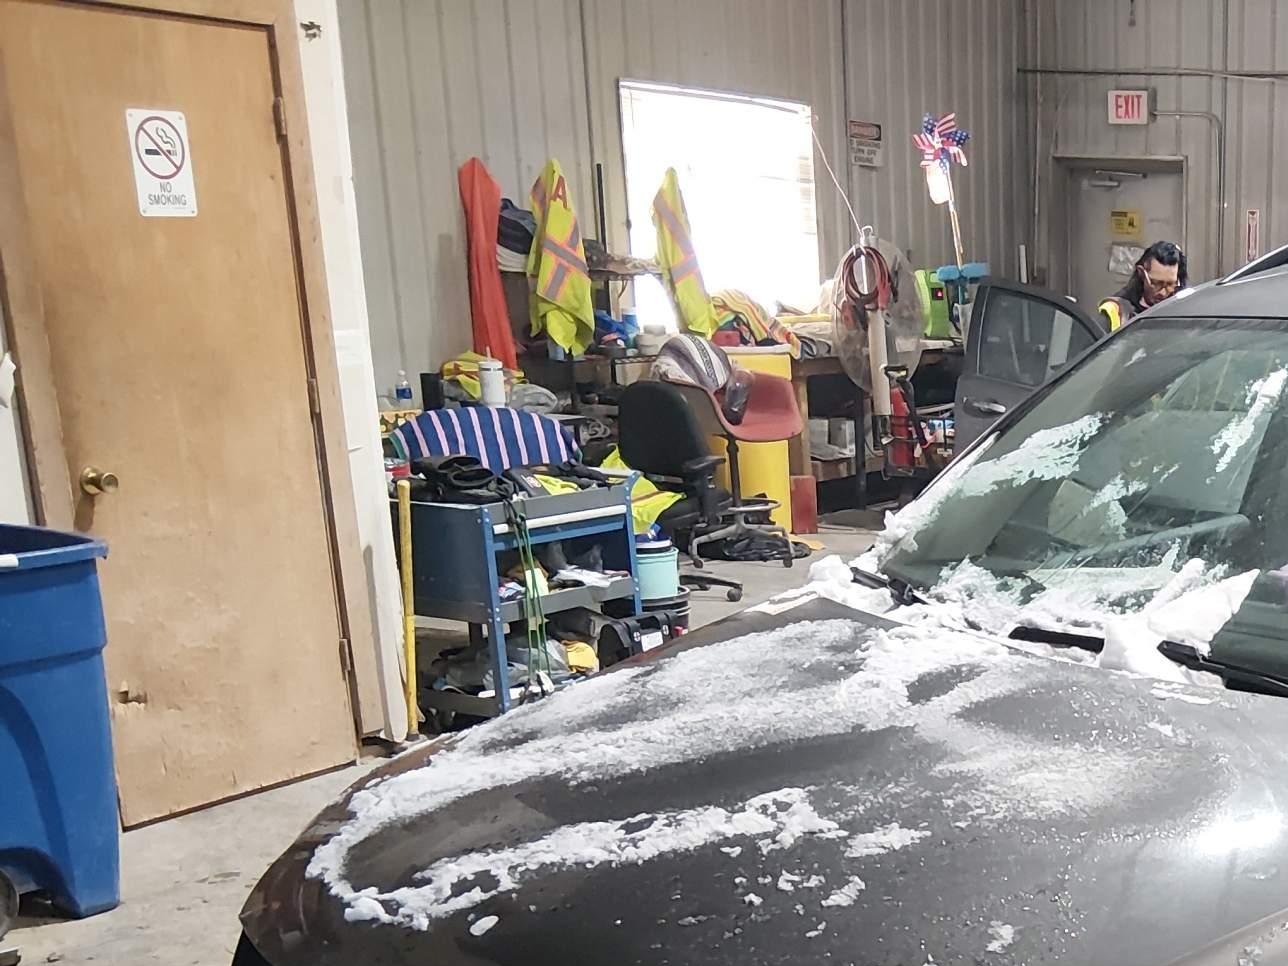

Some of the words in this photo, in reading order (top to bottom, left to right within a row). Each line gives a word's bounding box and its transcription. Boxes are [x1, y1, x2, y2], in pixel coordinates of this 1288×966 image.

[1114, 94, 1142, 120] EXIT
[160, 182, 172, 193] NO
[148, 194, 187, 206] SMOKING
